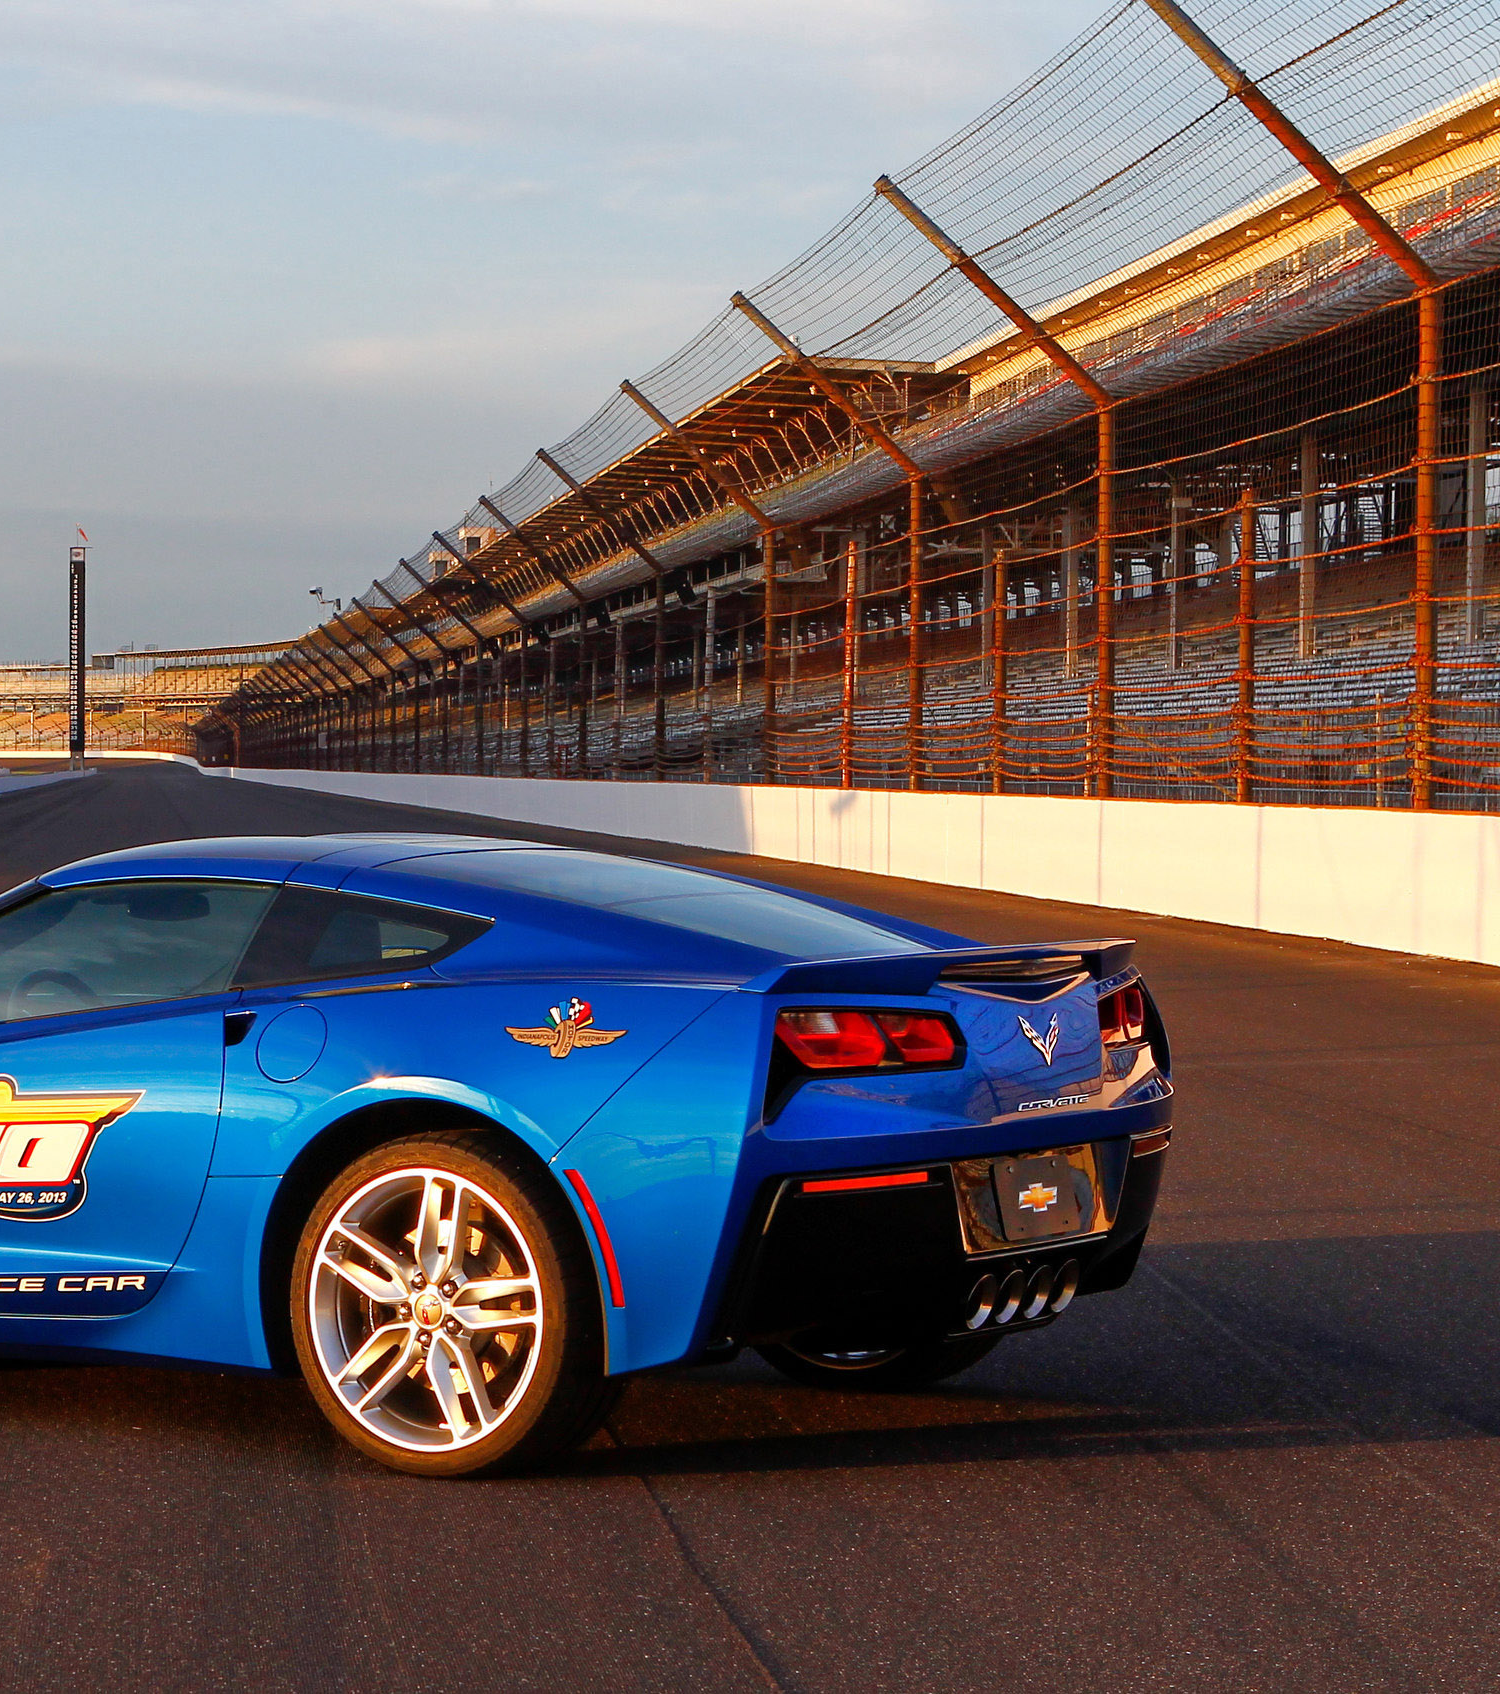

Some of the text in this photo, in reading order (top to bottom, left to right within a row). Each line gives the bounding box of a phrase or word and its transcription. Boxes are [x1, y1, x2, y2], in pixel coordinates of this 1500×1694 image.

[517, 1033, 557, 1041] INDIANAPOLIS
[16, 1192, 35, 1205] 26,
[37, 1191, 67, 1204] 2013
[56, 1274, 147, 1293] CAR
